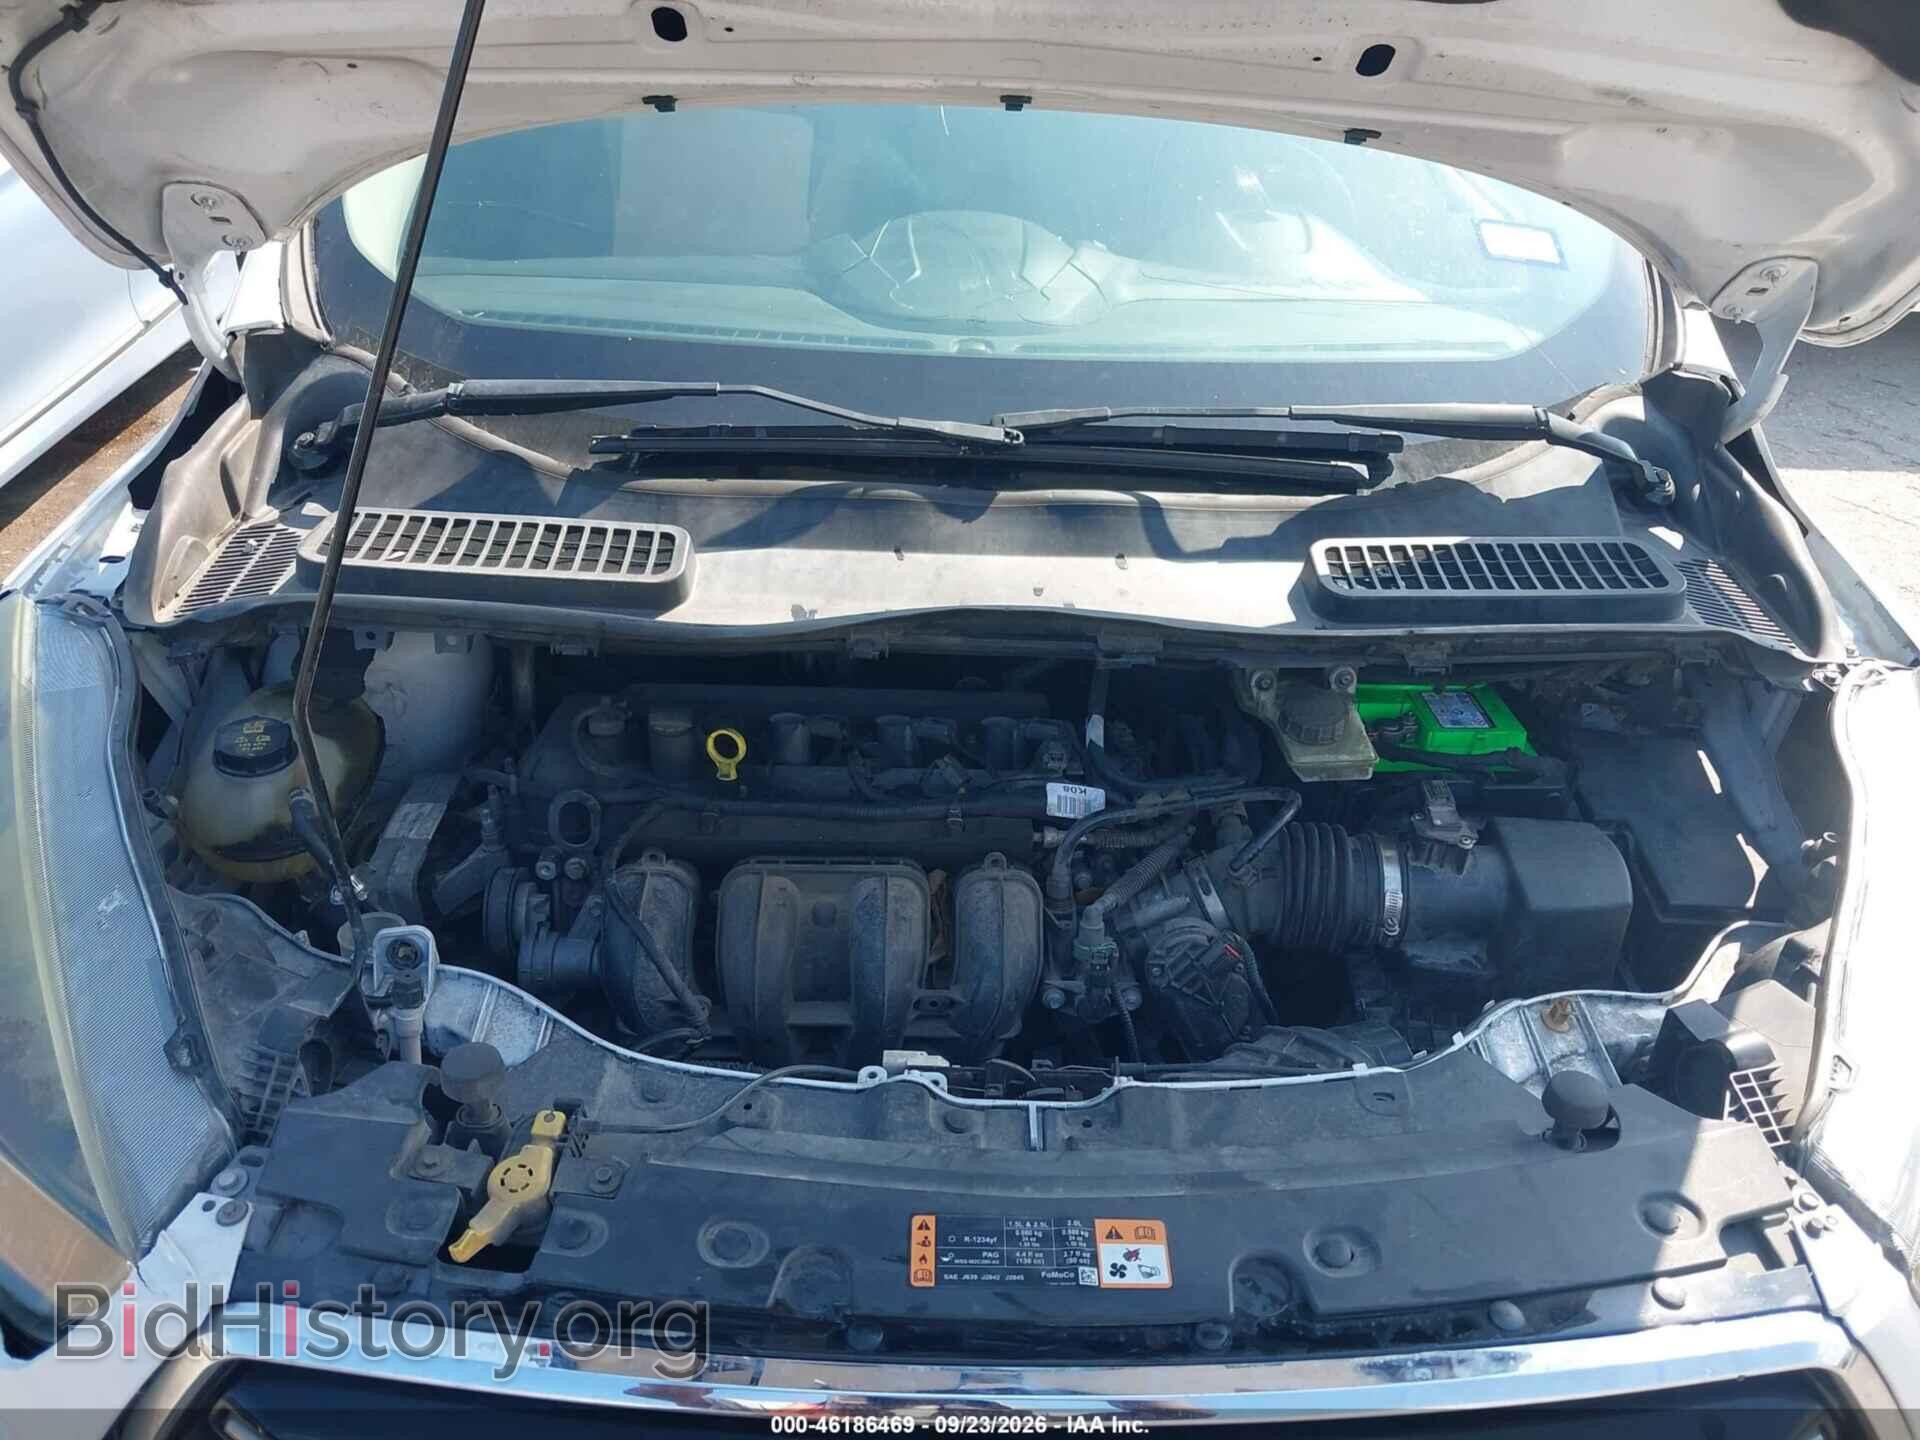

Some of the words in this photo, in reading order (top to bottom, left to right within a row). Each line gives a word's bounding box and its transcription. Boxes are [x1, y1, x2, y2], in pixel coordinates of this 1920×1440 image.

[963, 1236, 998, 1244] R-1234yf
[943, 1273, 959, 1281] SAE
[1041, 1271, 1075, 1279] FoMoCo
